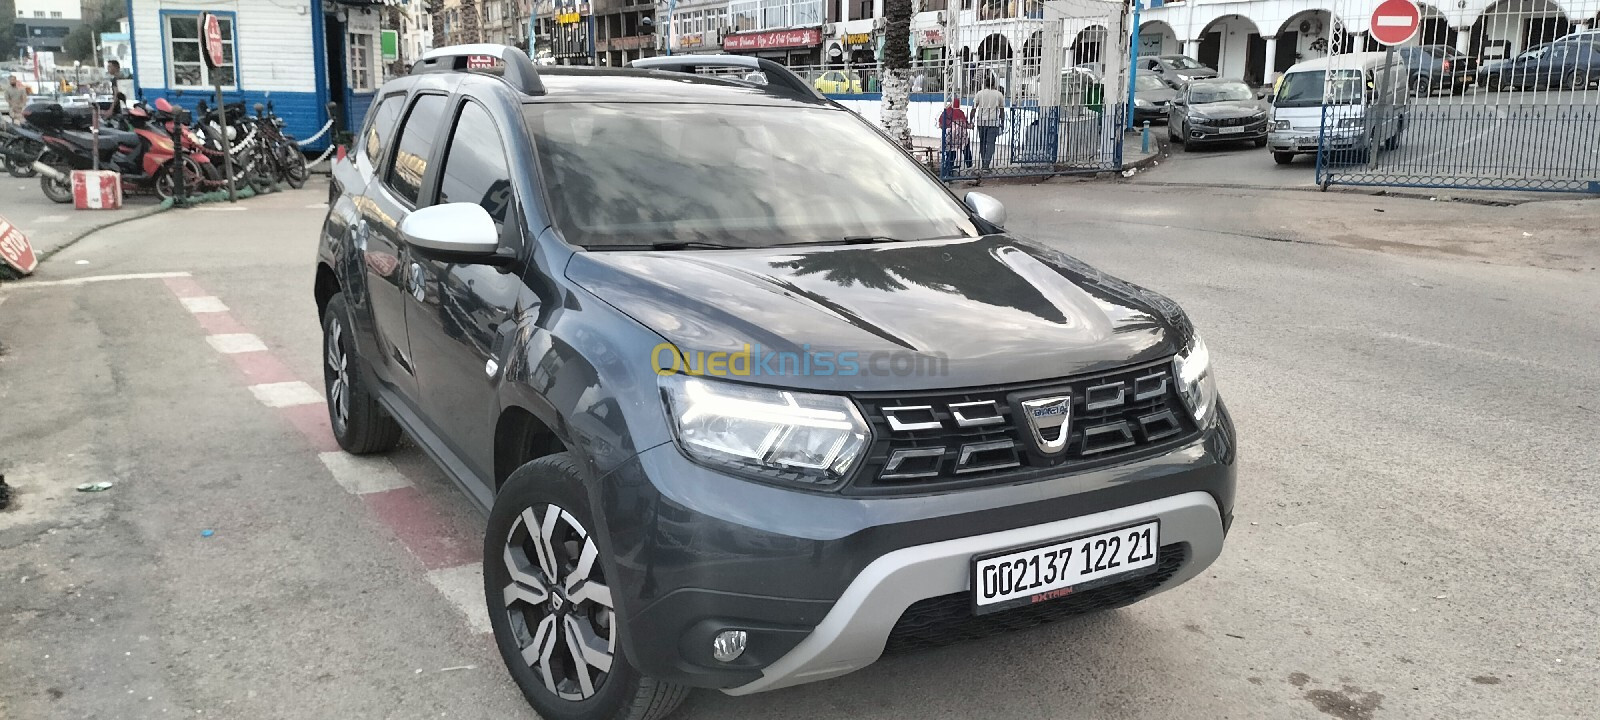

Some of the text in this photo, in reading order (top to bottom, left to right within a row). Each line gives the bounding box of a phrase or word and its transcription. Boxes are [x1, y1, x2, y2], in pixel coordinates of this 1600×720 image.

[0, 229, 28, 261] STOP
[1033, 405, 1068, 417] DACIA
[983, 528, 1154, 598] 002137 122 21
